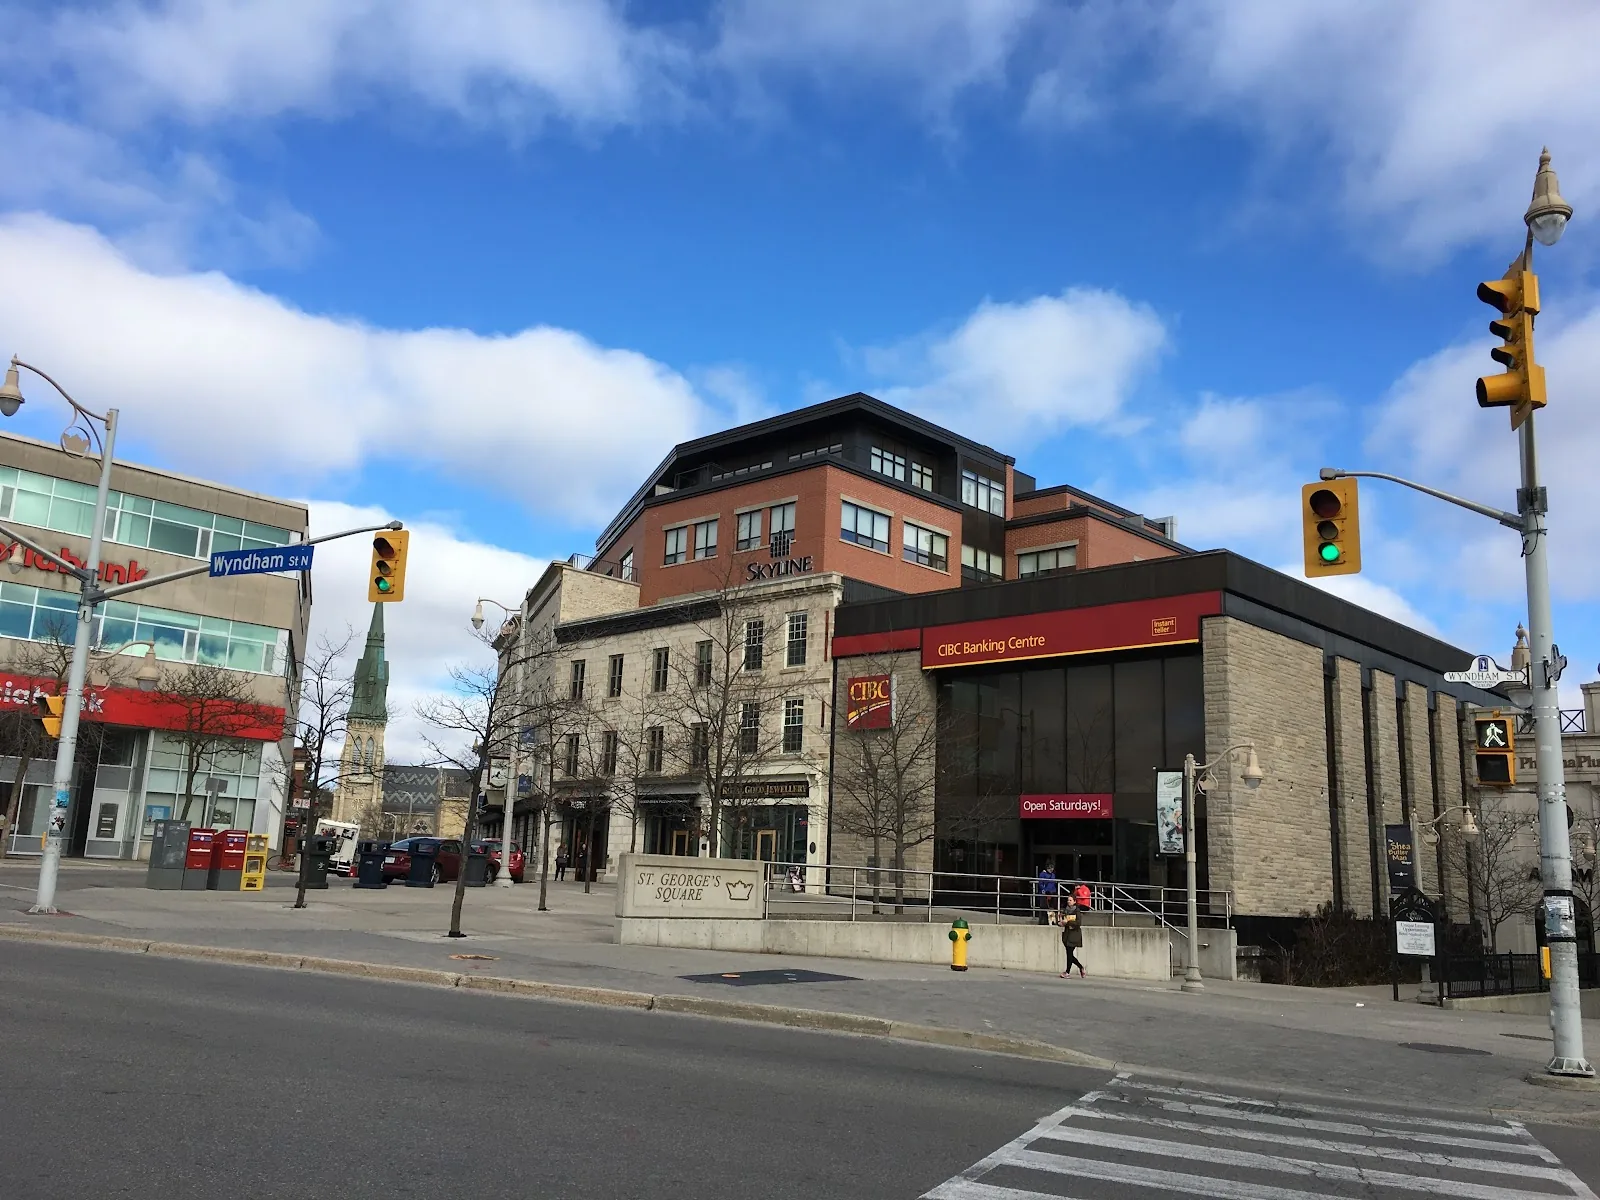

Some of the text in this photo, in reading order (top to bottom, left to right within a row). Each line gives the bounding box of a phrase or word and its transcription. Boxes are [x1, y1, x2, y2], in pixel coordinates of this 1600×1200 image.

[213, 553, 309, 576] Wyndham St N
[937, 634, 1046, 658] CIBC Banking Centre
[1447, 672, 1499, 681] WYNDHAM
[849, 679, 890, 701] CIBC
[1518, 755, 1600, 770] PhaPlu
[1023, 800, 1047, 814] Open
[1048, 799, 1101, 814] Saturdays!
[1390, 841, 1411, 850] Shea
[637, 872, 721, 888] ST. GEORGE'S
[655, 886, 704, 903] SQUARE
